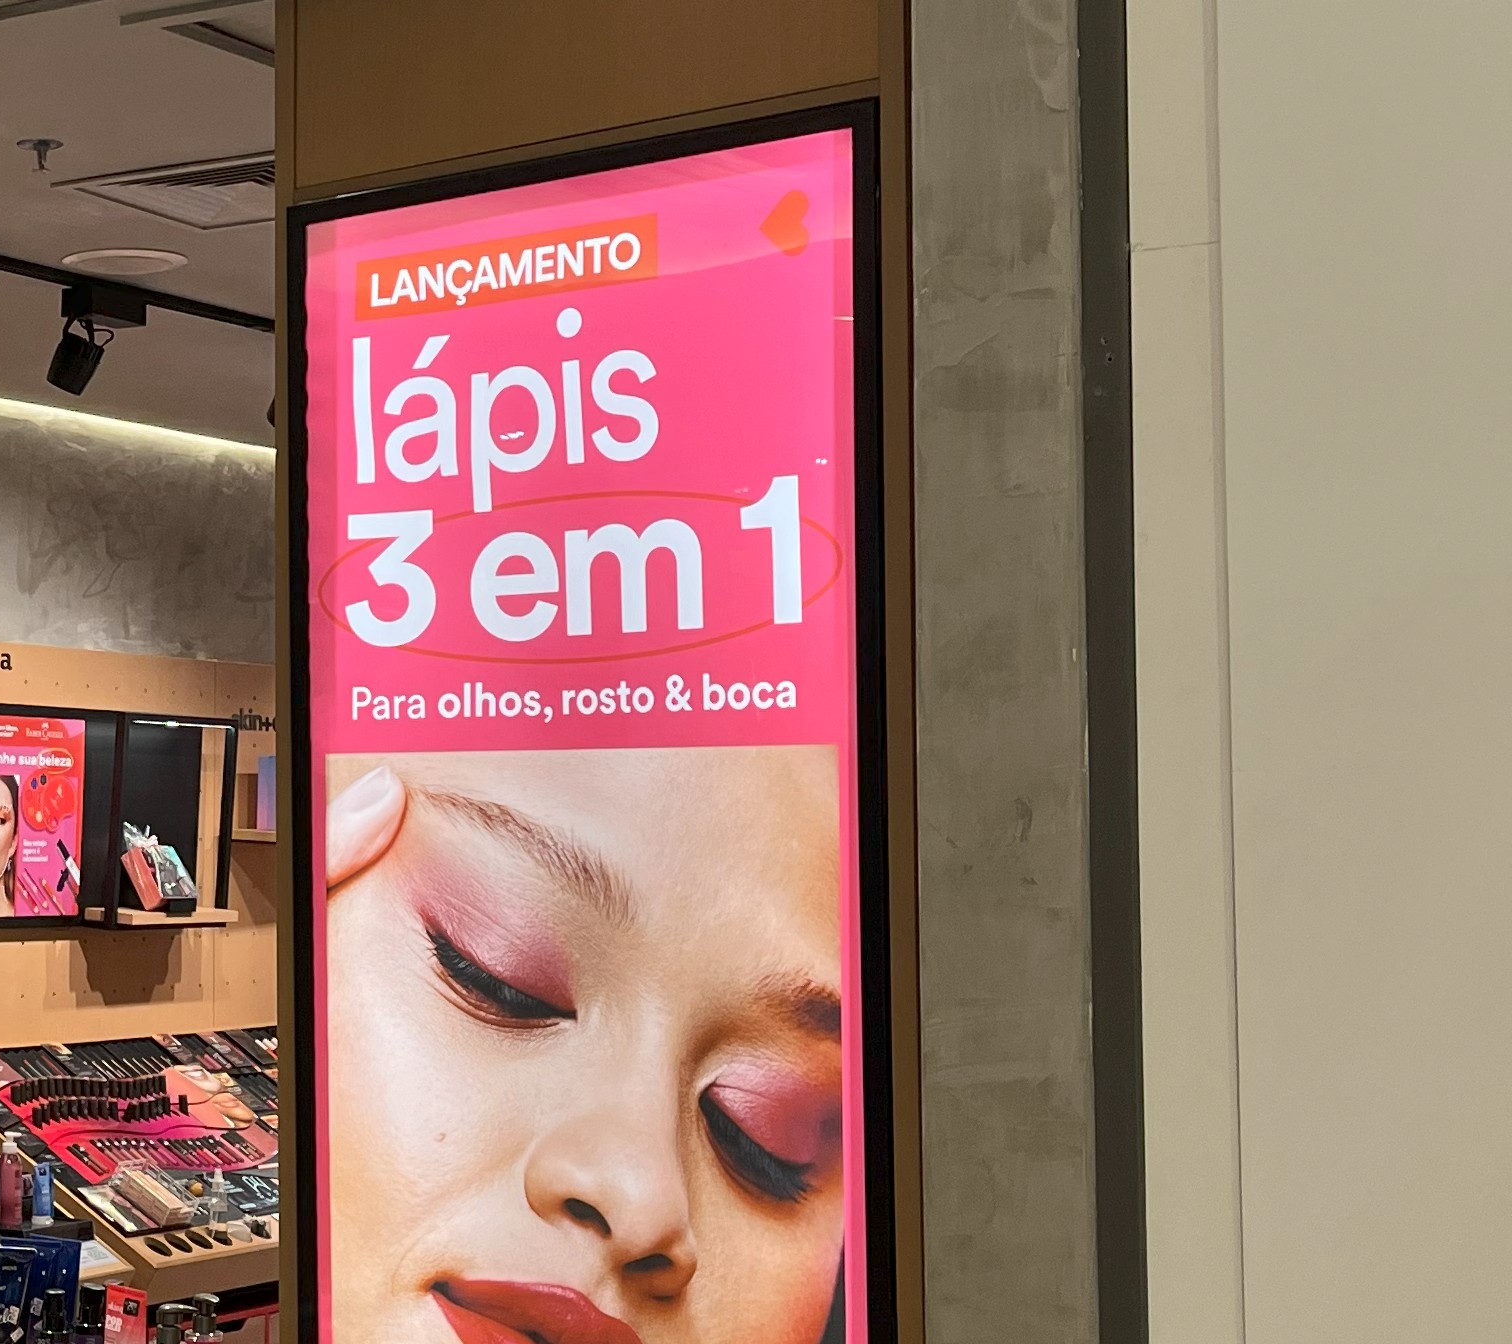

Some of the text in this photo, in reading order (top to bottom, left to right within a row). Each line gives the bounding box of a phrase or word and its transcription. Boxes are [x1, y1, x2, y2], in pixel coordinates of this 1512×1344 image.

[369, 232, 642, 308] LANÇAMENTO
[352, 307, 660, 514] lápis
[344, 474, 803, 647] 3 em 1
[351, 674, 797, 723] Para olhos, rosto & boca
[18, 755, 37, 766] sua
[38, 753, 72, 767] beleza
